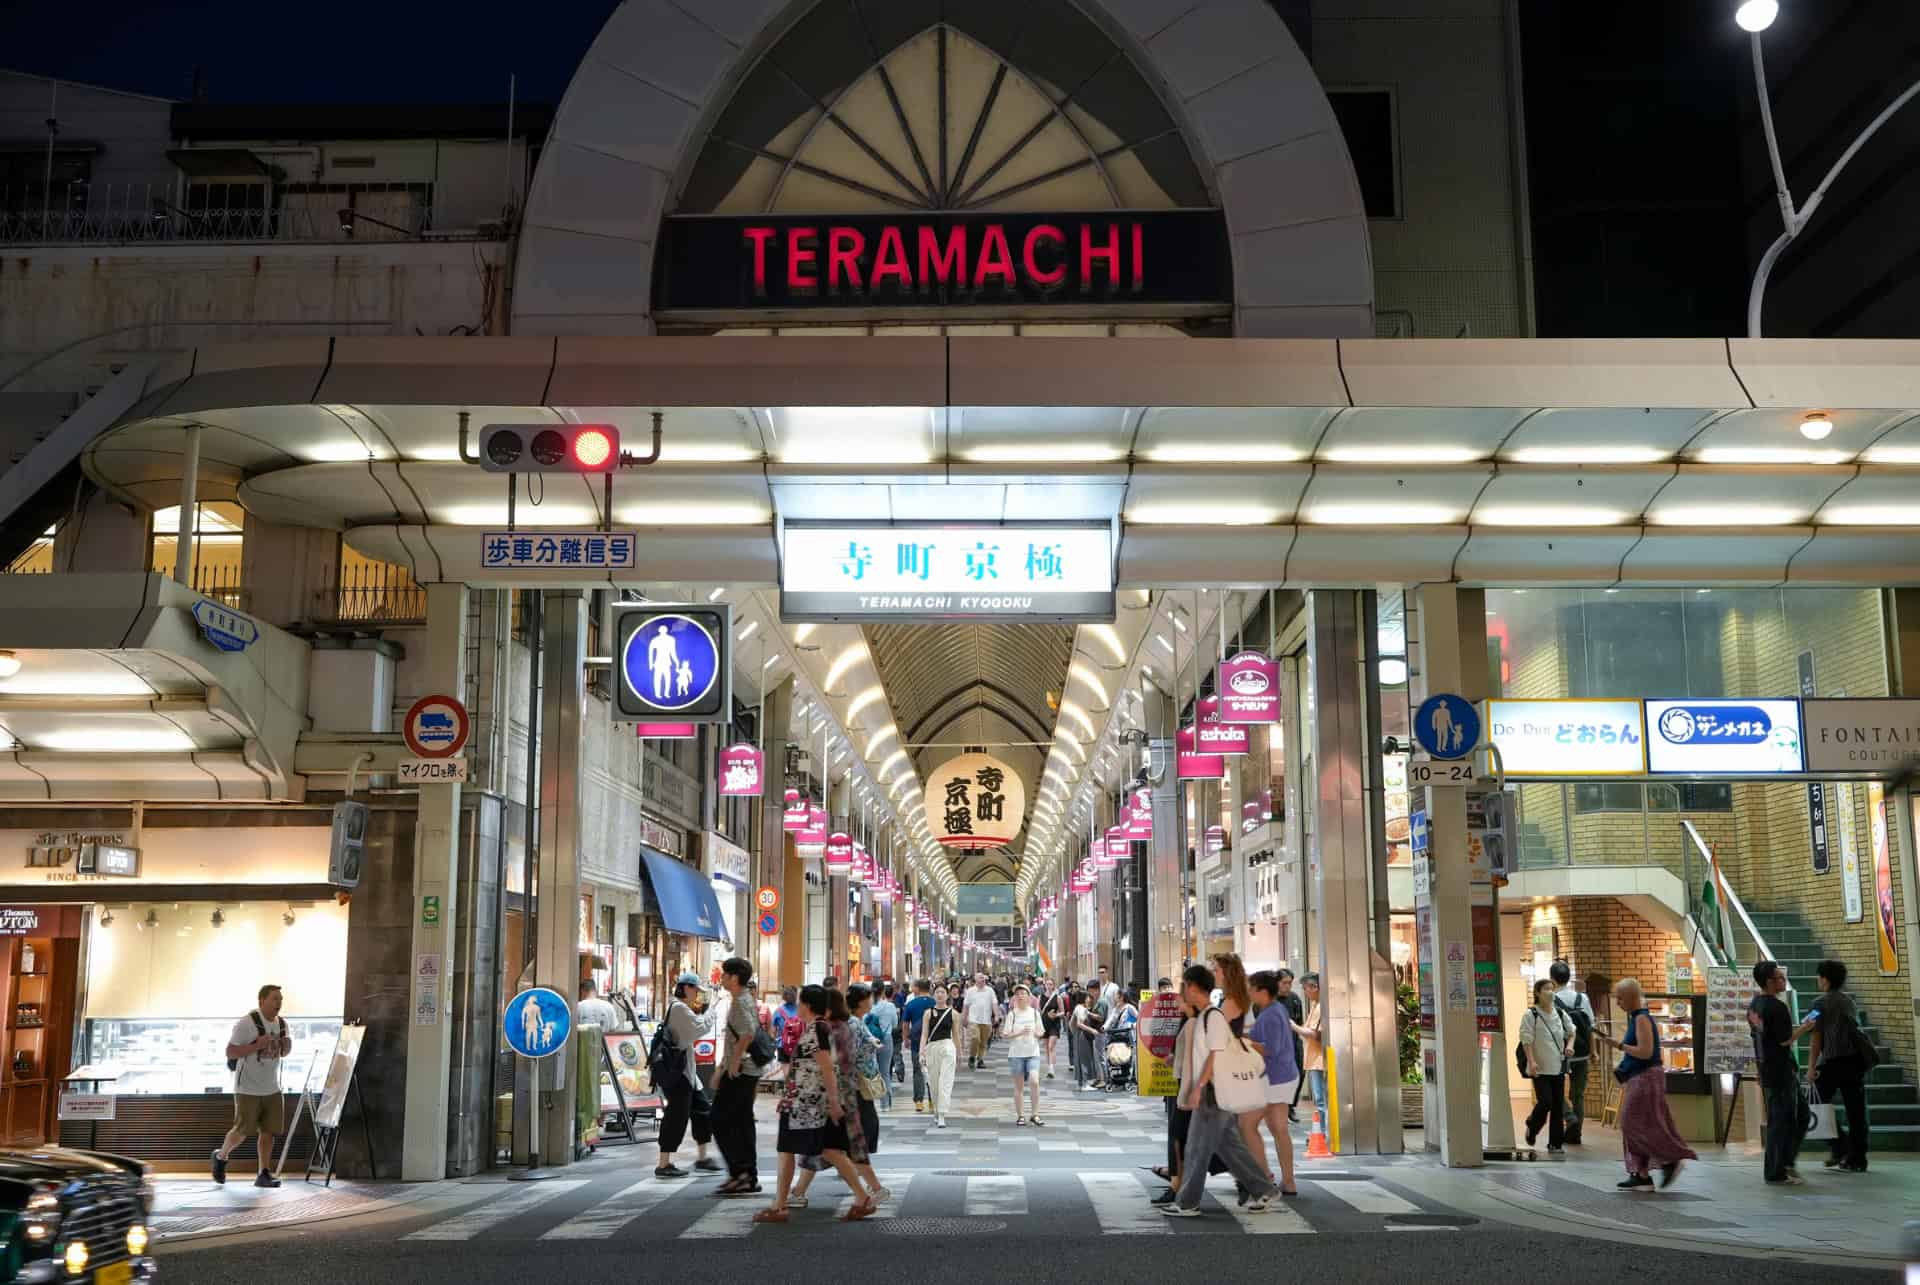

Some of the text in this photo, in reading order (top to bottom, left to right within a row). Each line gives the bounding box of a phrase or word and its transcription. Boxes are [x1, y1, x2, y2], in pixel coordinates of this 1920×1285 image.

[743, 223, 1144, 288] TERAMACHI
[488, 538, 630, 563] 歩車分離信号
[832, 541, 1065, 581] 寺町京極
[860, 596, 1033, 609] TERAMACHI KYOGOKU
[1493, 723, 1516, 736] Do
[1554, 723, 1640, 745] どおらん
[1820, 727, 1920, 743] FONTAI
[400, 763, 465, 777] マイクロを除く
[975, 766, 1006, 822] 寺町
[761, 892, 775, 904] 30
